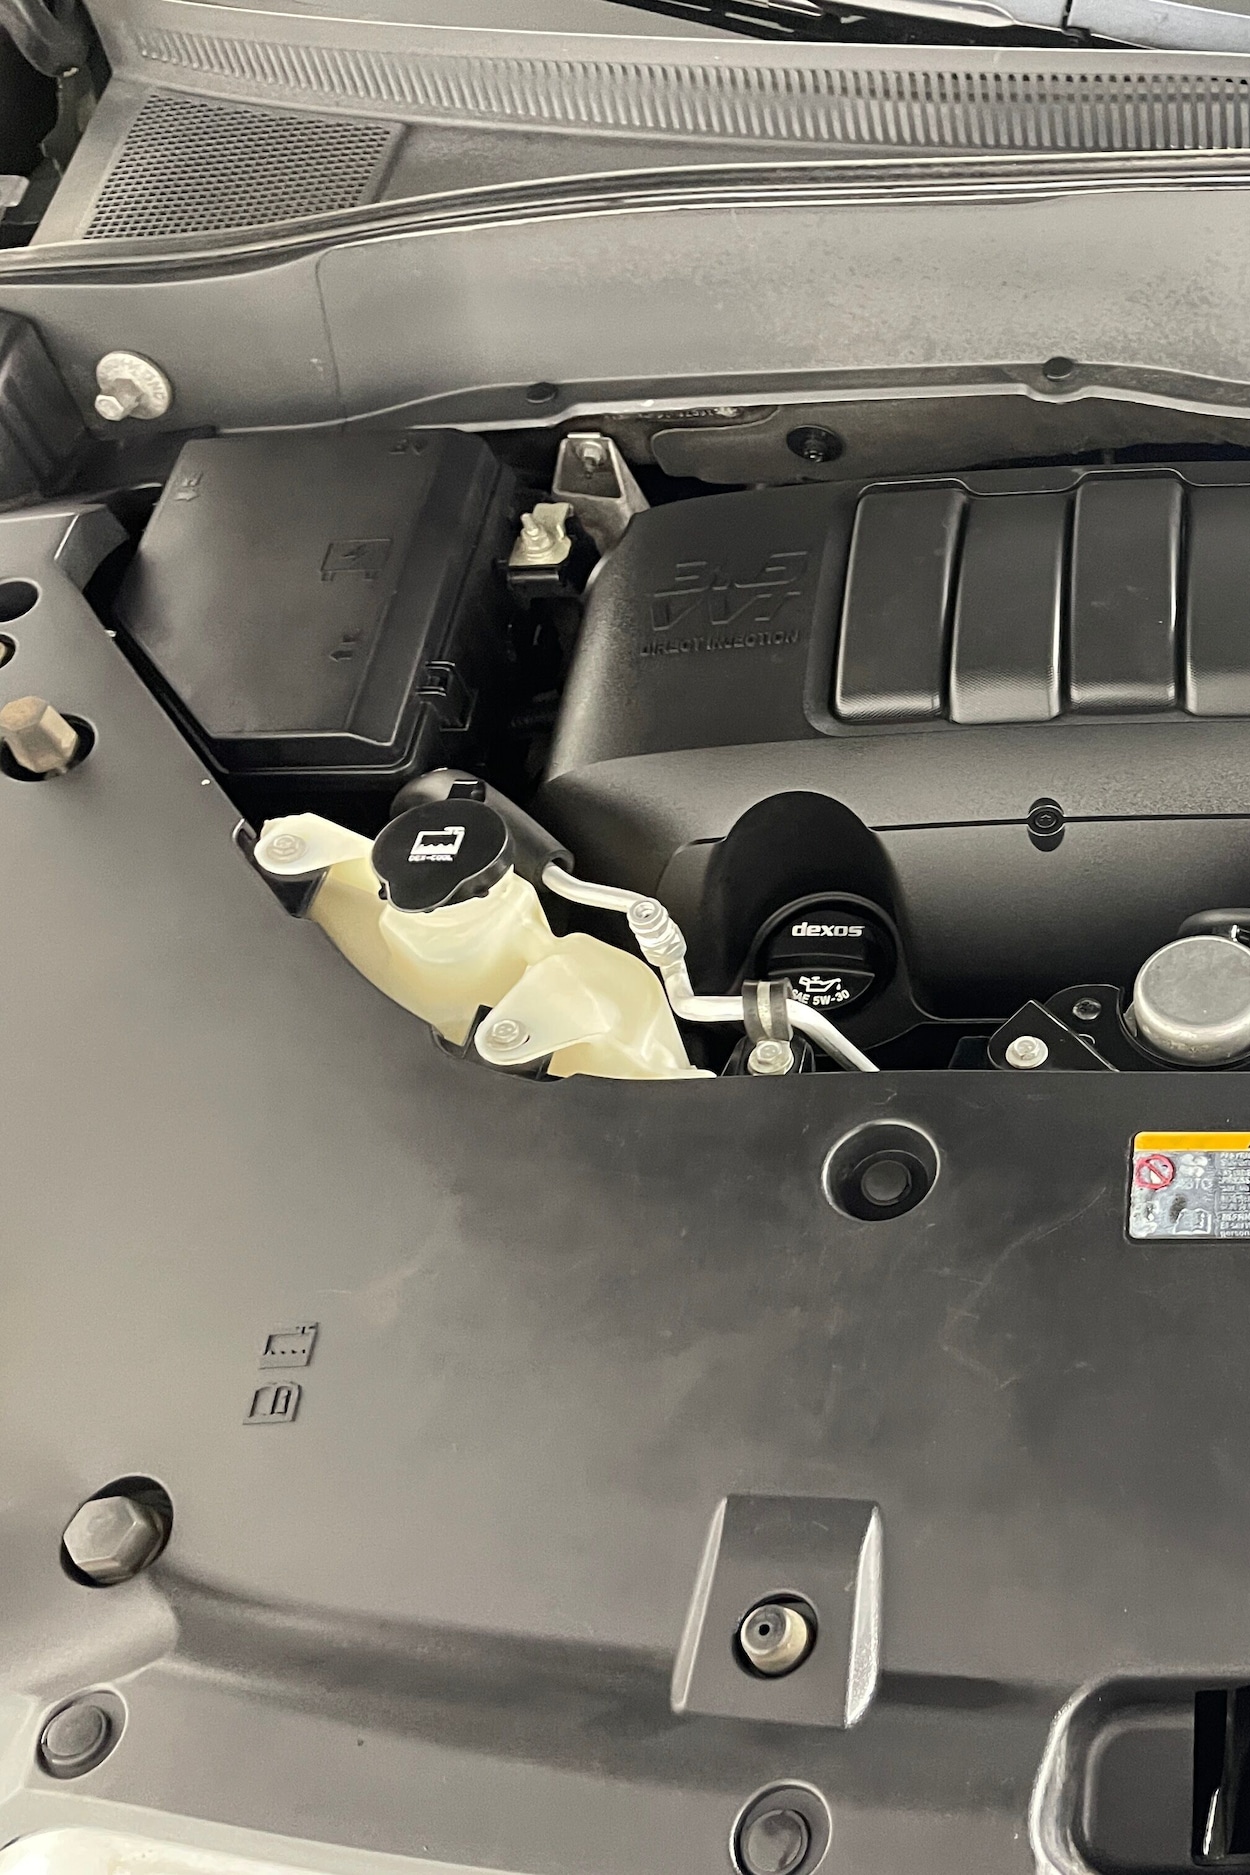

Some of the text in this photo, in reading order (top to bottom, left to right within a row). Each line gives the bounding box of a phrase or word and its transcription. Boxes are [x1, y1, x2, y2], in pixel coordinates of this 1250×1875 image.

[706, 630, 799, 650] INJECTION
[408, 854, 453, 862] DEX-COOL
[791, 922, 865, 937] dexos
[791, 988, 850, 1006] SAE 5W-30
